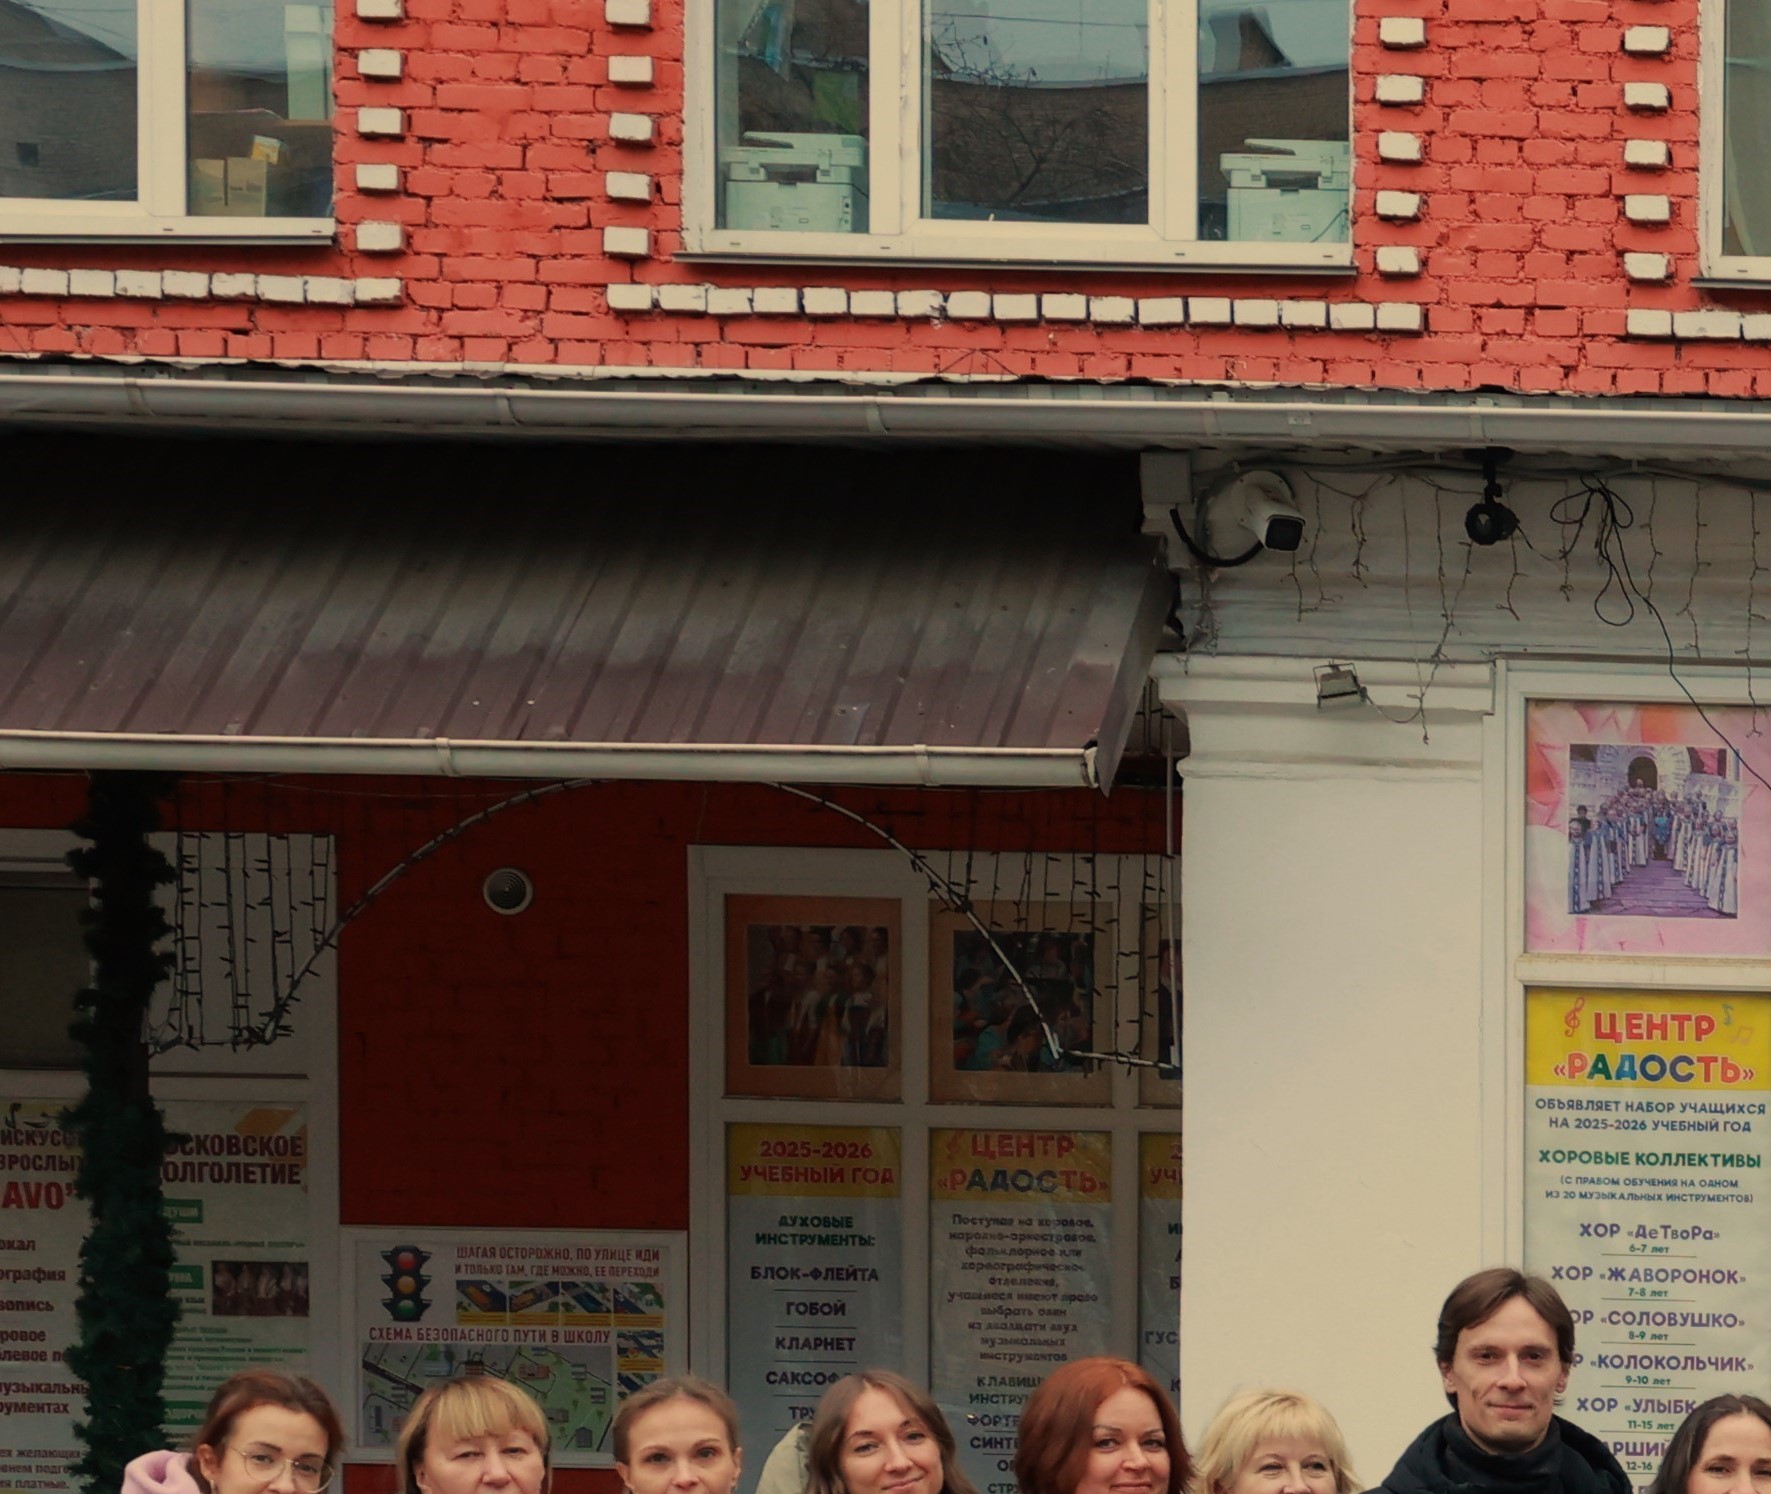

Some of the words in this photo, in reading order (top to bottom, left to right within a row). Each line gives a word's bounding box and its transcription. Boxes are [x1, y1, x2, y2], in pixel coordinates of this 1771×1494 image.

[1594, 1012, 1715, 1043] ЦЕНТР
[1554, 1052, 1754, 1083] «РАДОСТЬ»
[1535, 1099, 1620, 1112] ОБЪЯВЛЯЕТ
[1626, 1101, 1675, 1113] НАБОР
[1680, 1103, 1766, 1115] УЧАЩИХСЯ
[1549, 1118, 1569, 1128] НА
[1575, 1118, 1647, 1130] 2025-2026
[1652, 1119, 1718, 1132] УЧЕБНЫЙ
[1724, 1121, 1751, 1132] ГОД
[760, 1141, 872, 1158] 2025-2026
[971, 1135, 1074, 1160] ЦЕНТР
[1539, 1150, 1629, 1165] ХОРОВЫЕ
[1636, 1153, 1761, 1168] КОЛЛЕКТИВЫ
[161, 1161, 300, 1184] ОЛГОЛЕТИЕ
[740, 1163, 844, 1184] УЧЕБНЫЙ
[852, 1166, 894, 1184] ГОД
[938, 1168, 1107, 1192] «РАДОСТЬ»
[1576, 1177, 1619, 1186] ПРАВОМ
[1623, 1177, 1678, 1187] ОБУЧЕНИЯ
[1681, 1179, 1695, 1187] НА
[1699, 1180, 1738, 1188] ОДНОМ
[1579, 1192, 1662, 1201] МУЗЫКАЛЬНЫХ
[778, 1216, 852, 1228] ДУХОВЫЕ
[1579, 1224, 1621, 1238] ХОР
[756, 1233, 875, 1246] ИНСТРУМЕНТЫ:
[457, 1247, 496, 1259] ШАГАЯ
[500, 1248, 573, 1260] ОСТОРОЖНО,
[577, 1249, 590, 1260] ПО
[594, 1250, 633, 1262] УЛИЦЕ
[636, 1250, 659, 1261] ИДИ
[750, 1264, 879, 1281] БЛОК-ФЛЕЙТА
[1551, 1266, 1593, 1280] ХОР
[1600, 1268, 1746, 1284] «ЖАВОРОНОК»
[786, 1300, 846, 1316] ГОБОЙ
[1601, 1311, 1745, 1327] «СОЛОВУШКО»
[369, 1328, 411, 1340] СХЕМА
[418, 1328, 509, 1342] БЕЗОПАСНОГО
[514, 1329, 548, 1342] ПУТИ
[552, 1330, 558, 1342] В
[564, 1330, 610, 1343] ШКОЛУ
[775, 1338, 856, 1351] КЛАРНЕТ
[1591, 1354, 1753, 1371] «КОЛОКОЛЬЧИК»
[1577, 1398, 1618, 1412] ХОР
